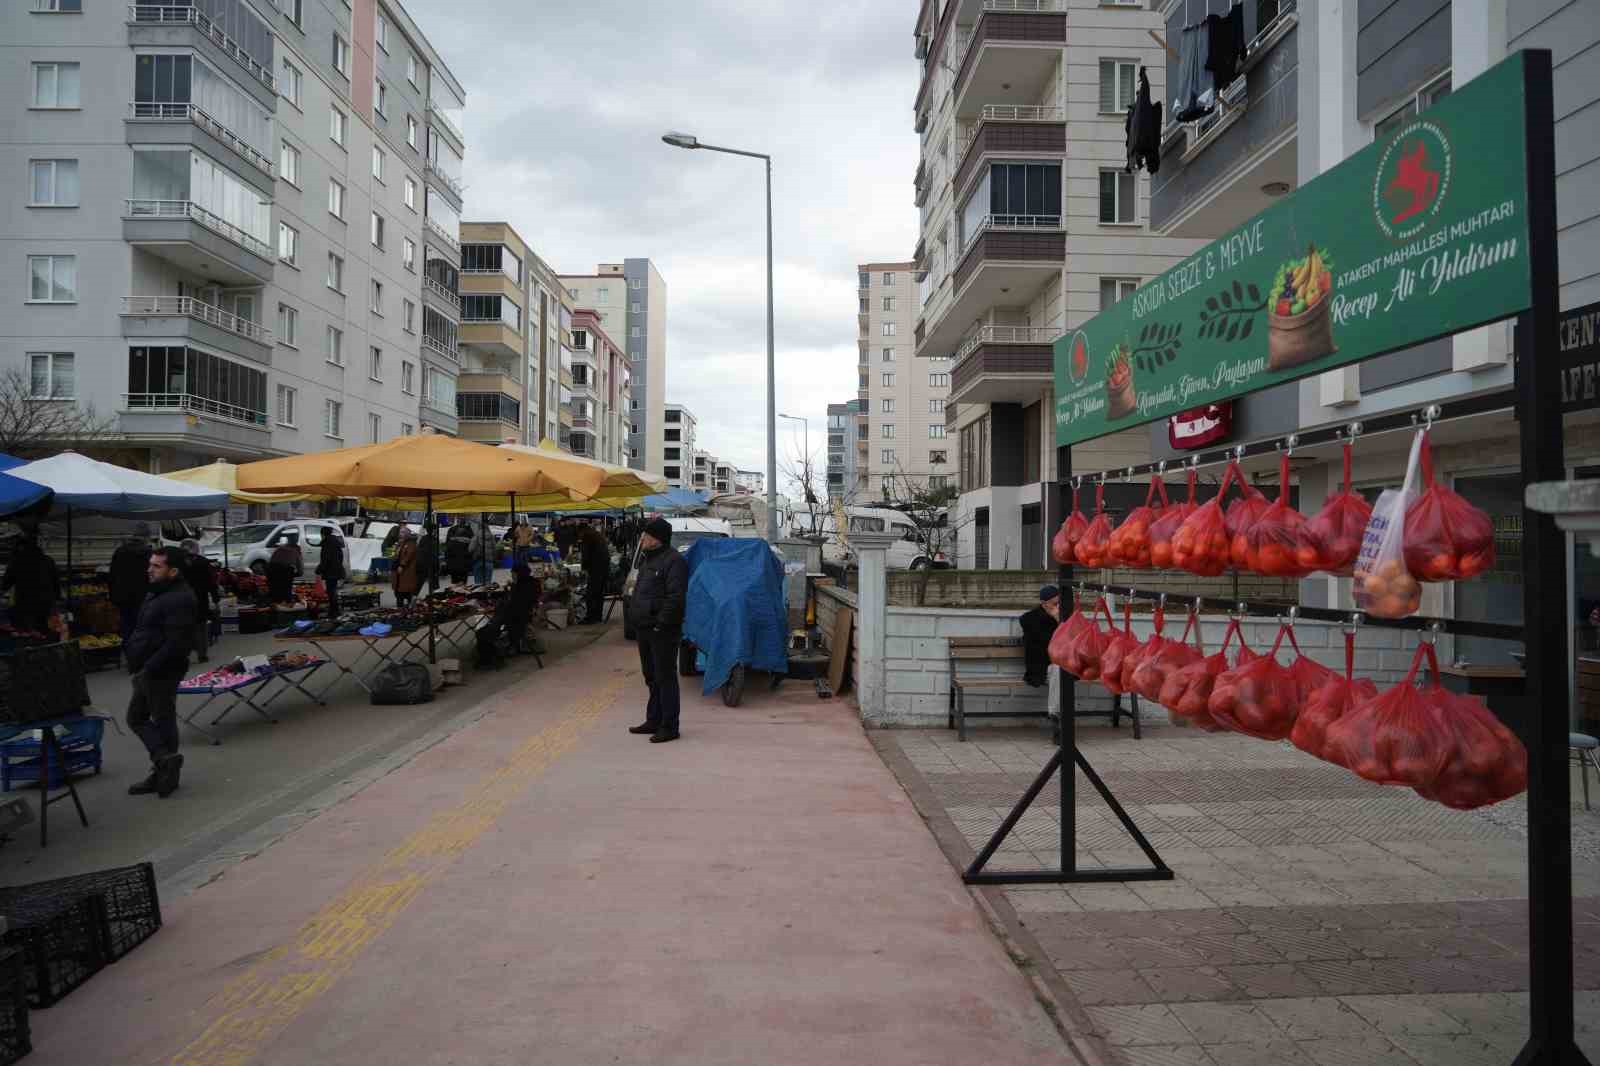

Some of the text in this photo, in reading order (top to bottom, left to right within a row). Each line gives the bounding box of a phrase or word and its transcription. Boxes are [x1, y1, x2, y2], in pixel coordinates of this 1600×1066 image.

[1132, 219, 1265, 320] ASKIDA SEBZE & MEYVE
[1337, 199, 1514, 289] ATAKENT MAHALLESİ MUHTARI
[1330, 292, 1379, 326] Recep
[1384, 267, 1416, 312] Ali
